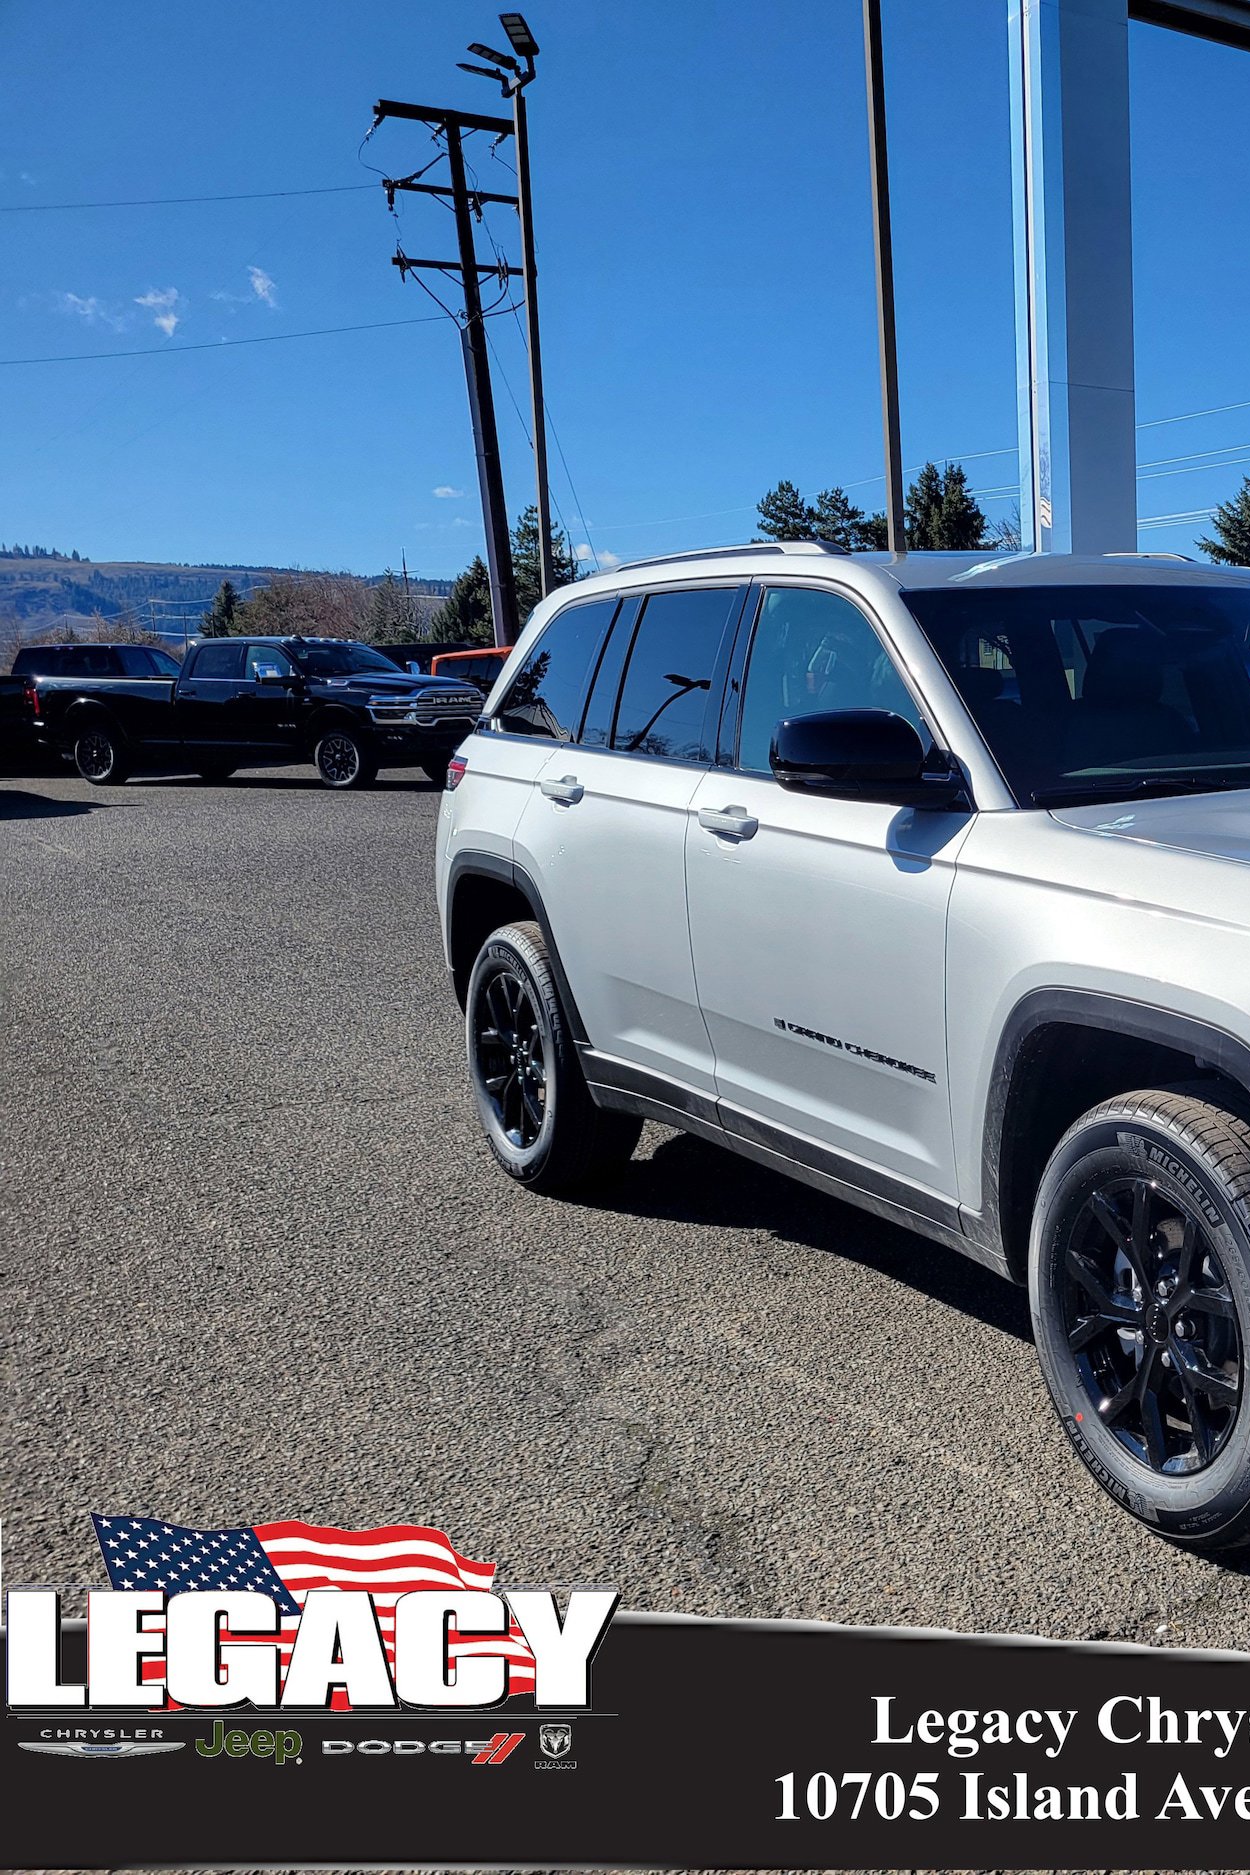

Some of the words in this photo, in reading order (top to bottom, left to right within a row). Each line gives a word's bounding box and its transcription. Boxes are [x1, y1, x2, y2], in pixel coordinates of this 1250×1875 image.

[436, 696, 471, 704] RAM
[787, 1022, 843, 1050] GRAND
[845, 1041, 937, 1084] CHEROKEE
[1150, 1146, 1220, 1228] MICHELIN
[1066, 1420, 1127, 1499] MICHELIN
